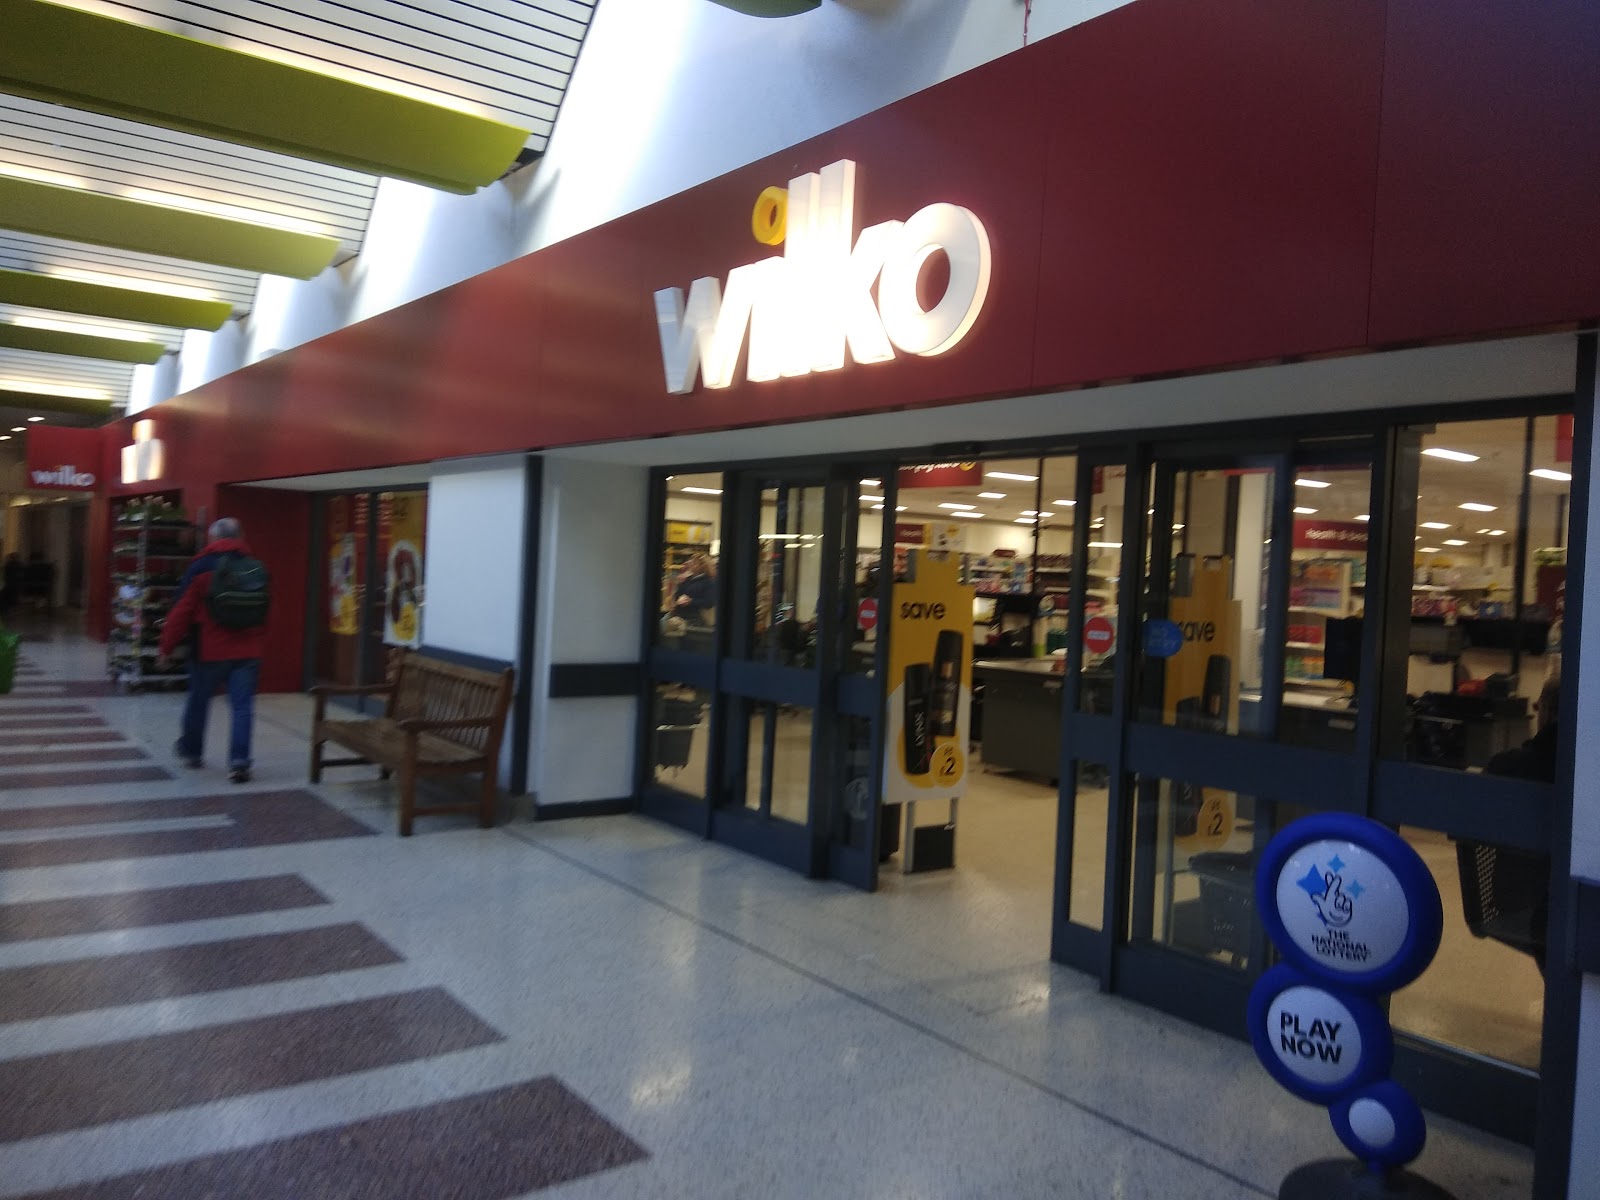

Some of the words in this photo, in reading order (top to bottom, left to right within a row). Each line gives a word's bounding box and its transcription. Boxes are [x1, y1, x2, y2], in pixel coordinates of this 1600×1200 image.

[654, 158, 992, 395] wilko
[31, 464, 96, 487] wilko
[901, 600, 945, 620] save
[1311, 934, 1368, 953] NATIONAL
[1327, 928, 1350, 941] THE
[1315, 944, 1369, 962] LOTTERY
[1280, 1011, 1342, 1044] PLAY
[1280, 1034, 1342, 1064] NOW
